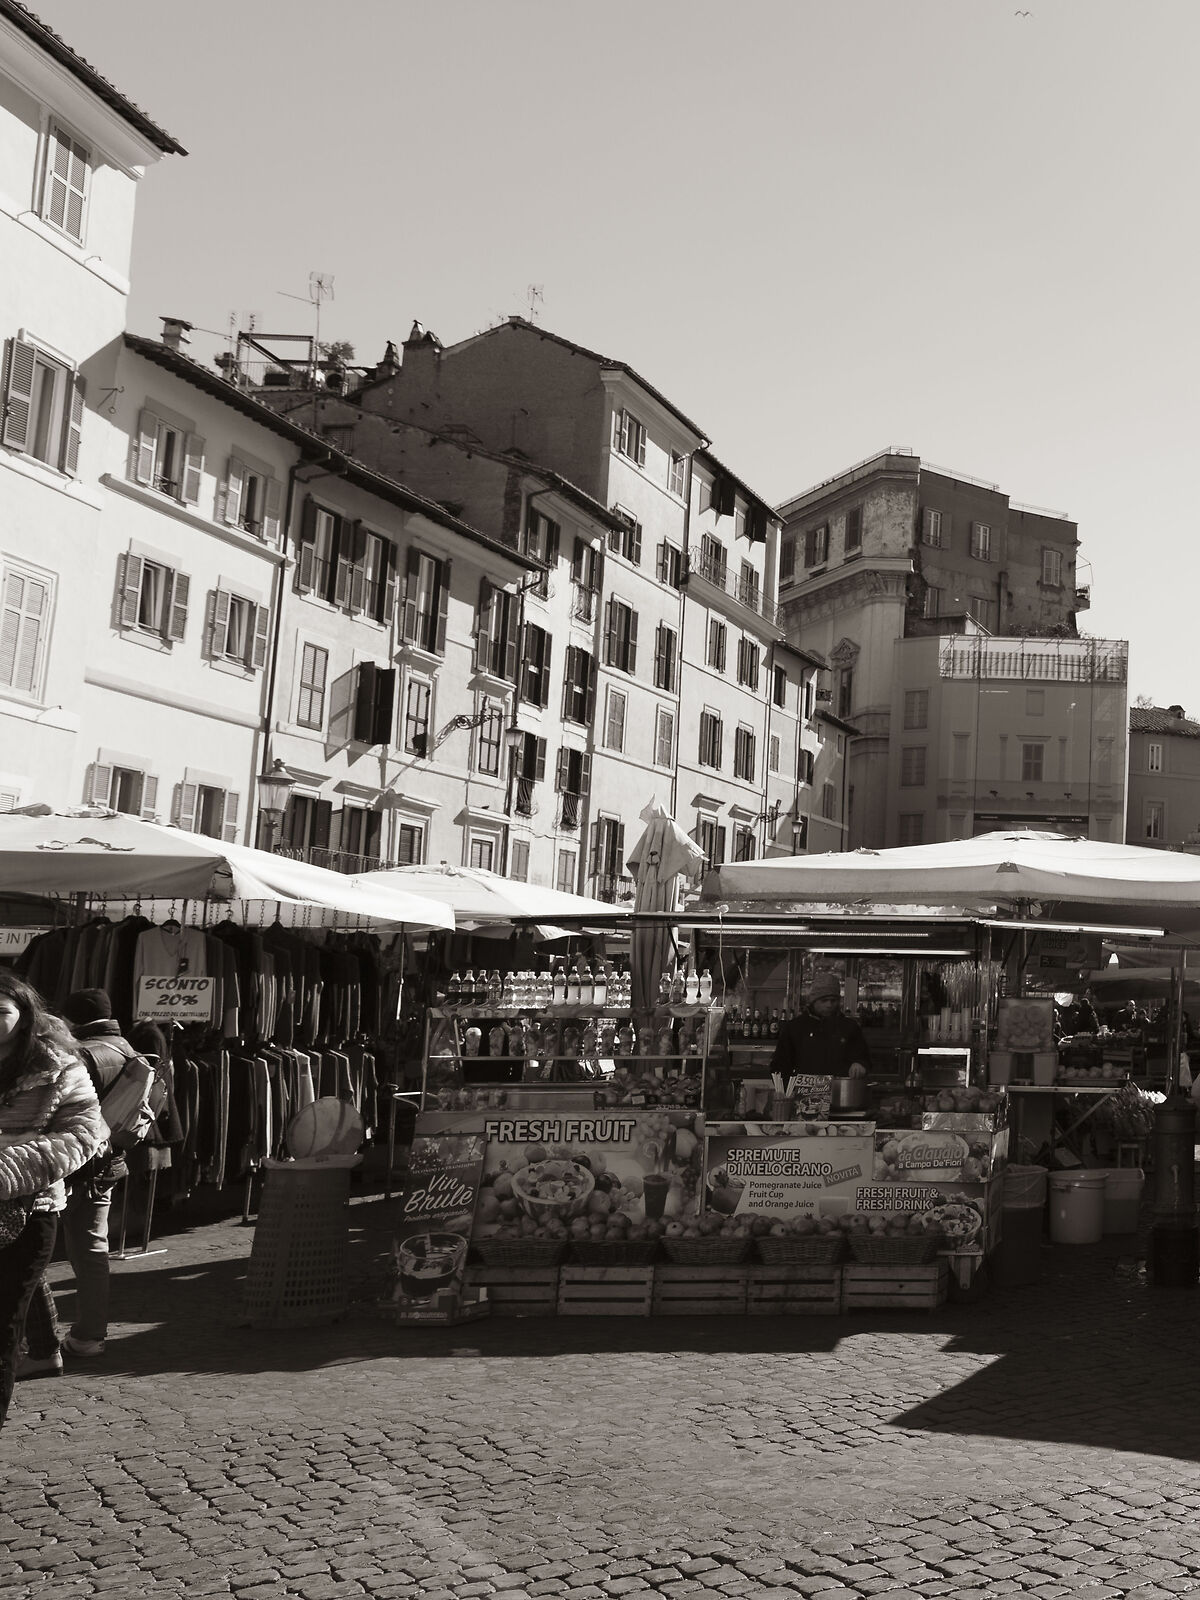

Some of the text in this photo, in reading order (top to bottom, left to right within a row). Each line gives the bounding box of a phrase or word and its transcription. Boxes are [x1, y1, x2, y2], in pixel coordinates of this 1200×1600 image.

[6, 932, 20, 944] IN
[145, 978, 209, 991] SCONTO
[157, 994, 198, 1006] 20%
[485, 1120, 636, 1142] FRESH FRUIT
[727, 1149, 800, 1162] SPREMUTE
[898, 1143, 965, 1161] da Claudio
[726, 1163, 833, 1177] DI MELOGRANO
[905, 1161, 931, 1169] Campo
[428, 1173, 458, 1193] Vin
[750, 1181, 822, 1190] Pomegranate Juice
[749, 1190, 784, 1200] Fruit Cup
[856, 1187, 939, 1199] FRESH FRUIT &
[748, 1200, 815, 1210] and Orange Juice
[856, 1199, 931, 1210] FRESH DRINK
